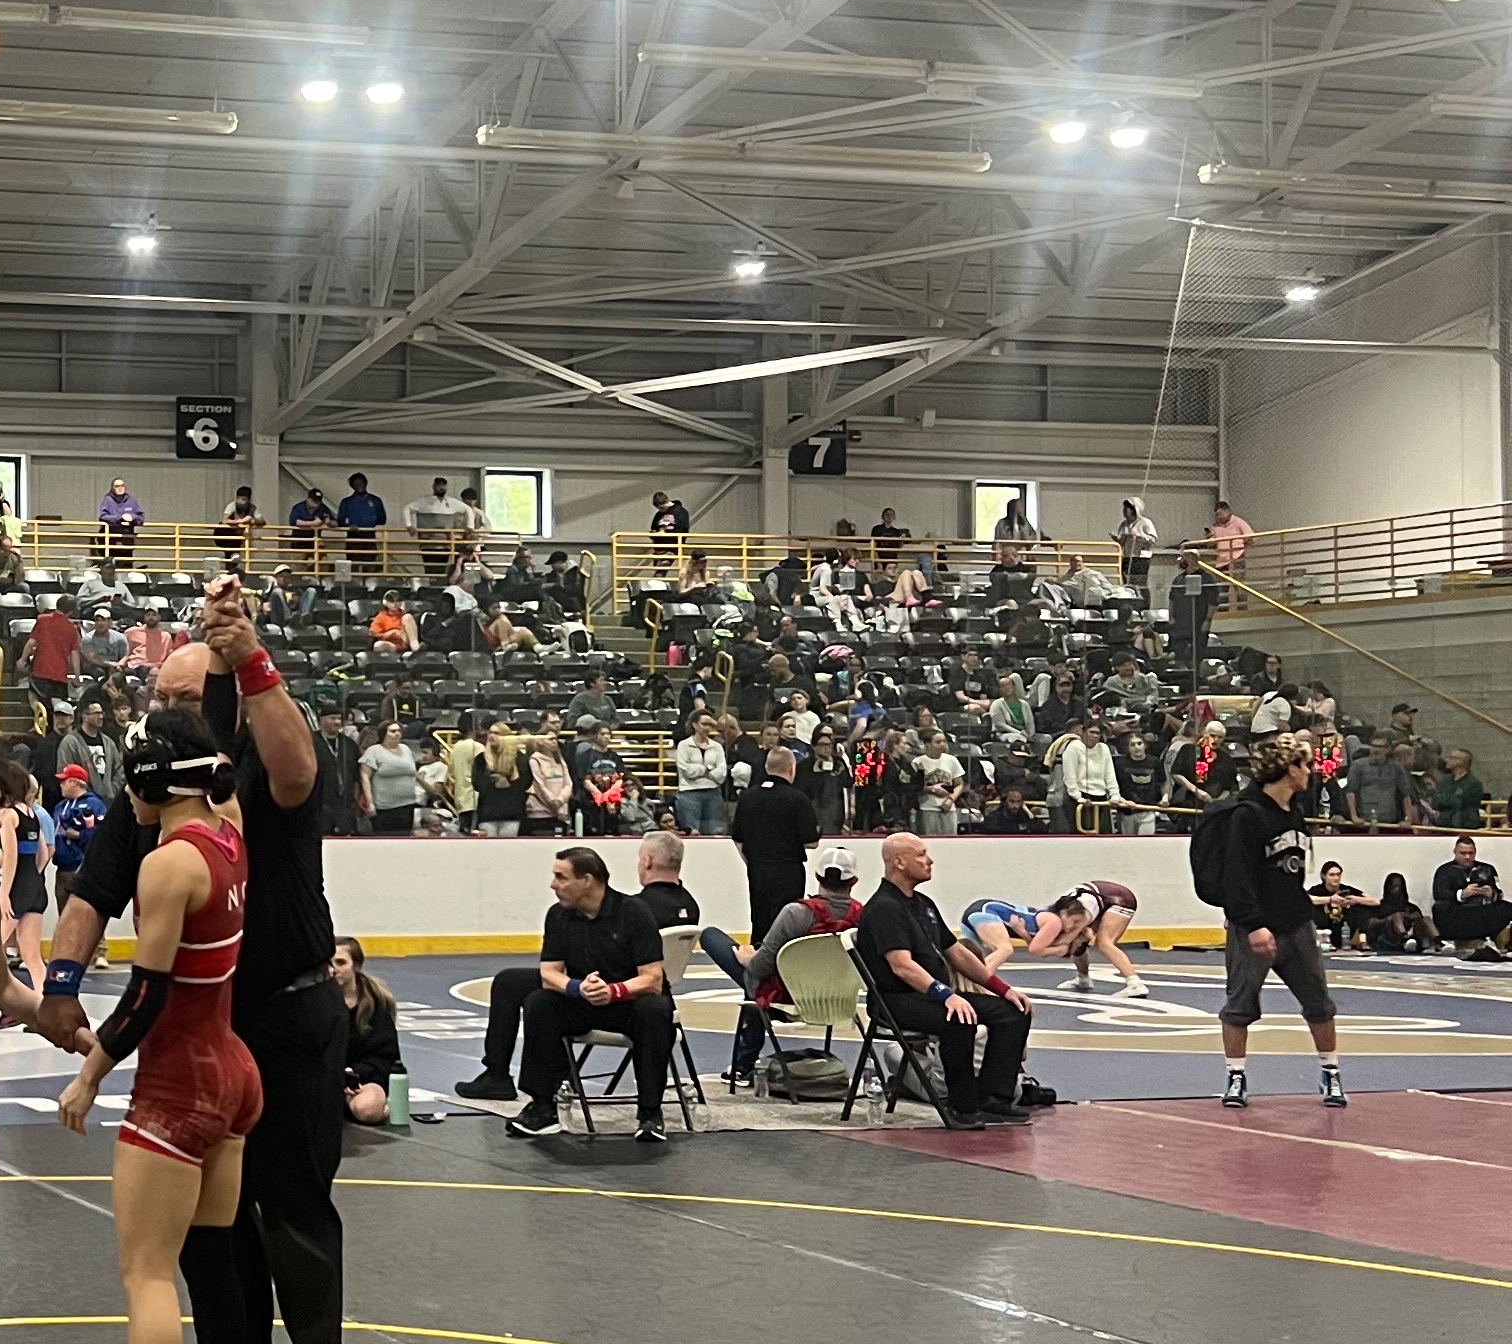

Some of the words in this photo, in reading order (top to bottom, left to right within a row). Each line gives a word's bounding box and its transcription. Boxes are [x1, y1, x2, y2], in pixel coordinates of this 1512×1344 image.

[180, 405, 232, 413] SECTION
[192, 418, 219, 452] 6
[808, 437, 831, 468] 7
